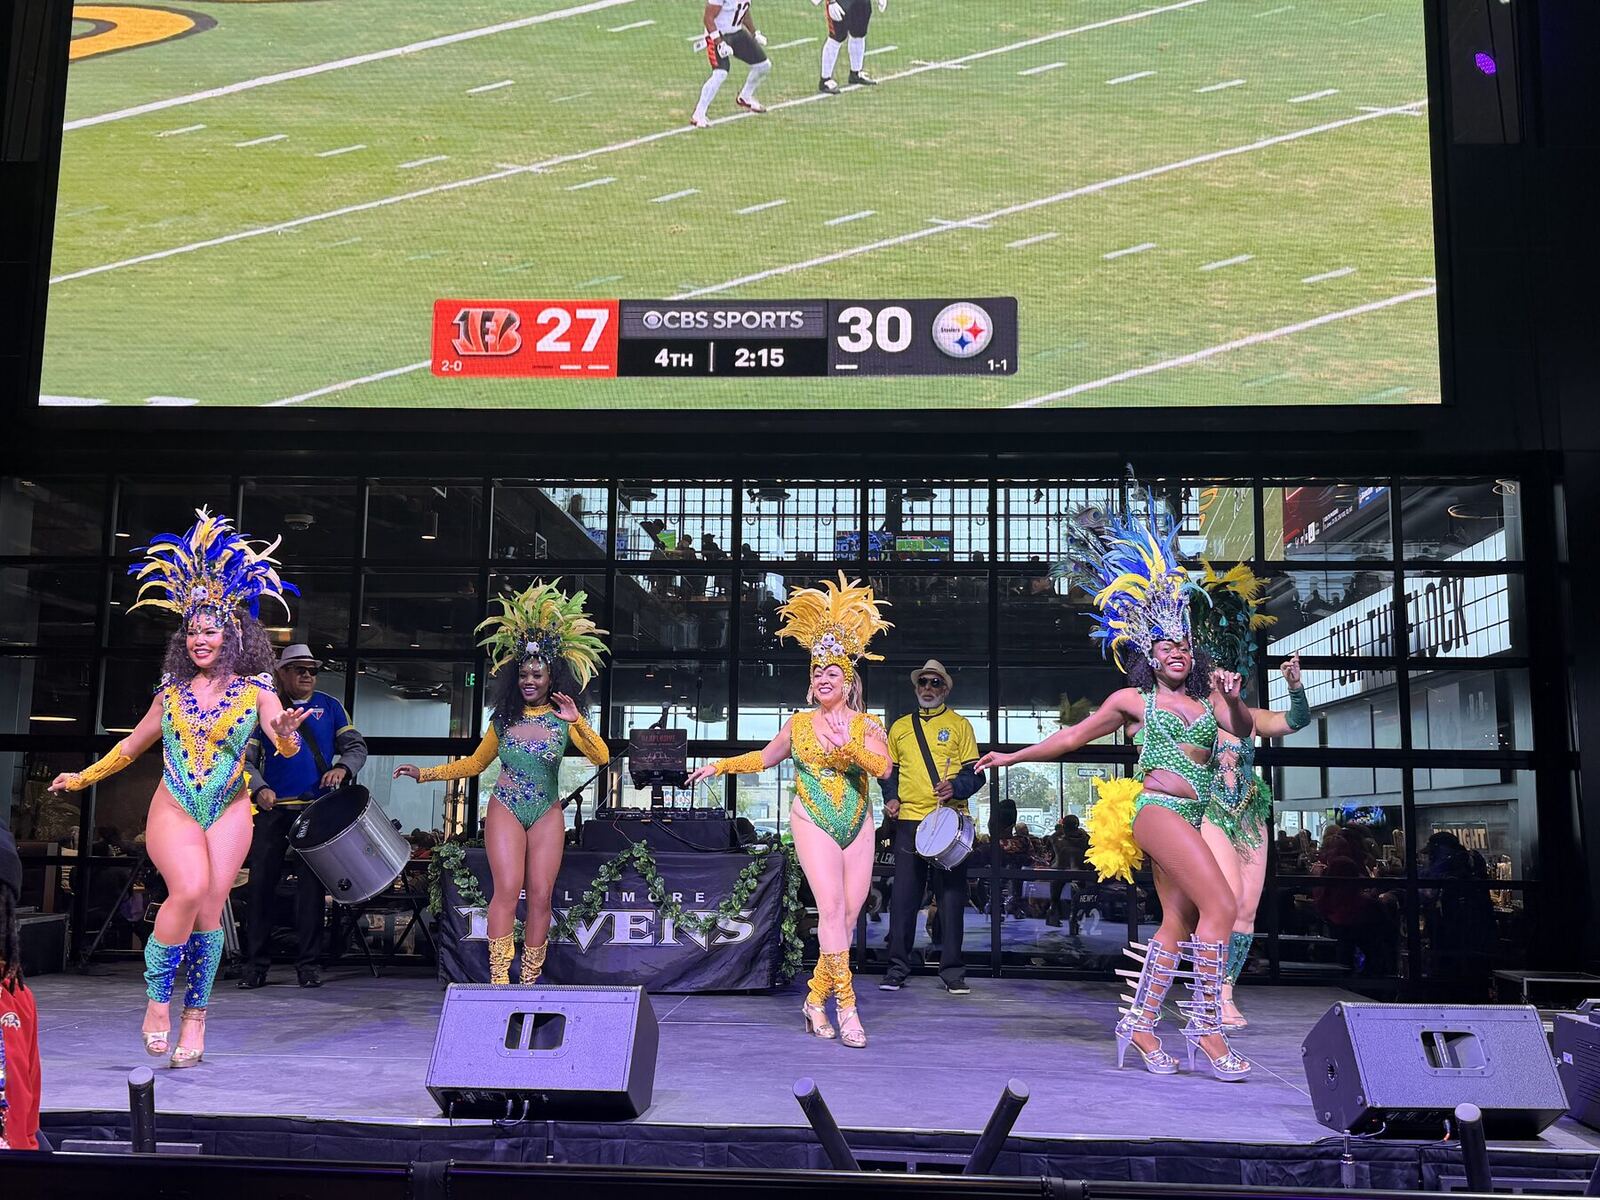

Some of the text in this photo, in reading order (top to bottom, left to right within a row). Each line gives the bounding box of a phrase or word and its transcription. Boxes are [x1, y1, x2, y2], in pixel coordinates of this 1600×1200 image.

[663, 310, 804, 329] CBS SPORTS
[836, 306, 912, 353] 30
[536, 307, 610, 353] 27
[441, 360, 462, 371] 2-0
[654, 347, 785, 368] 4TH 2:15
[987, 358, 1007, 371] 1-1
